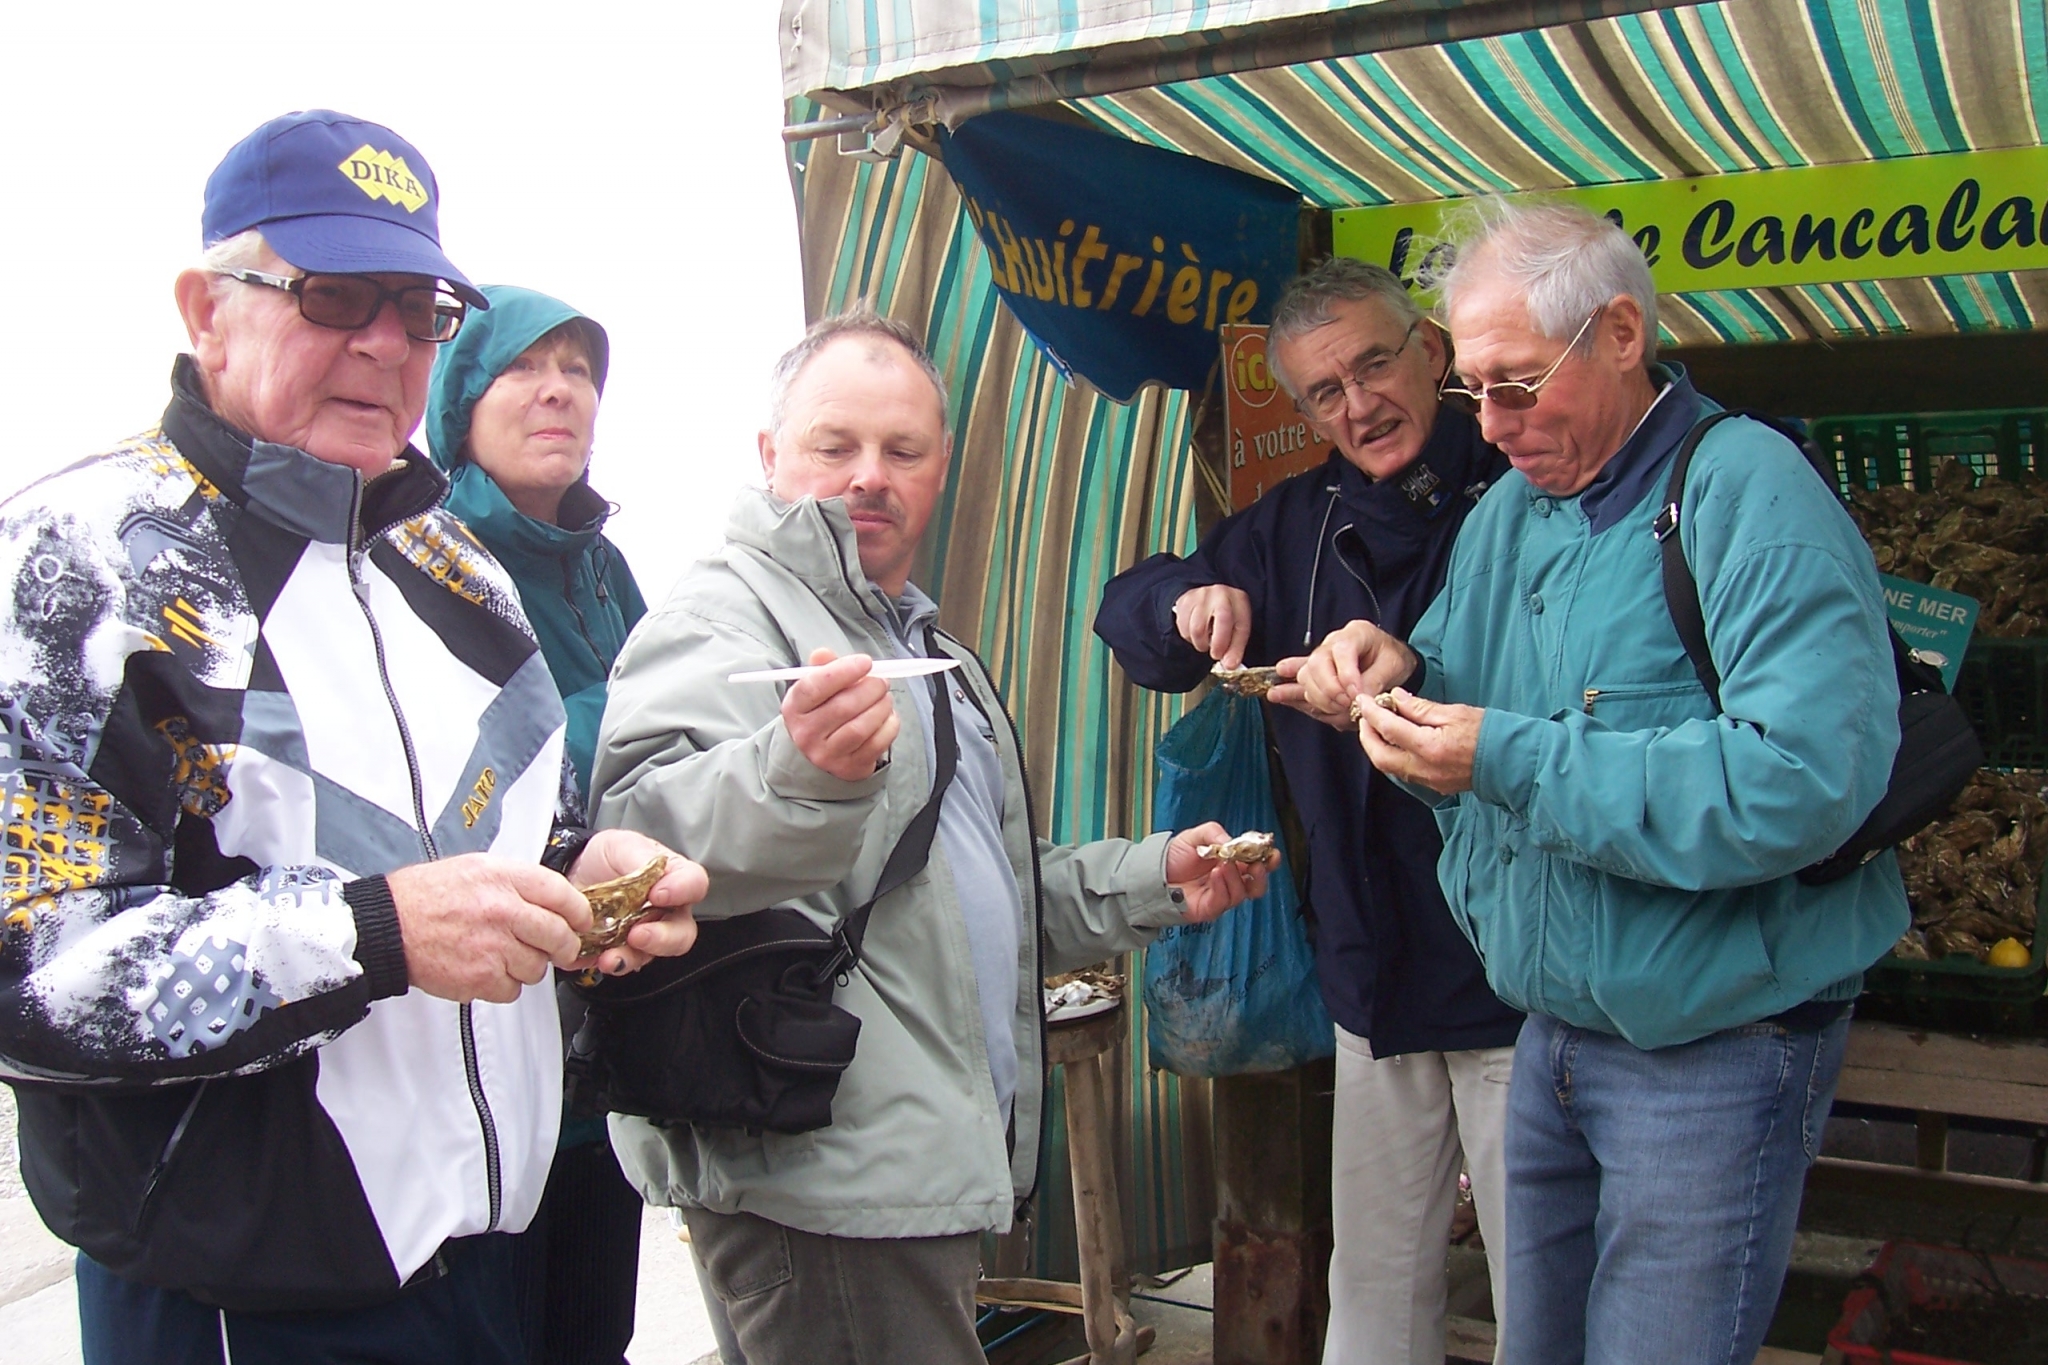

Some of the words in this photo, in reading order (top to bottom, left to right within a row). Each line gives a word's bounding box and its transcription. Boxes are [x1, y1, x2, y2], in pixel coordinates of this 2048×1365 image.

[350, 160, 422, 199] DIKA
[1682, 179, 2048, 270] Cancala
[1234, 427, 1246, 468] à
[1253, 422, 1307, 461] votre
[1883, 588, 1914, 610] NE
[1917, 597, 1968, 625] MER
